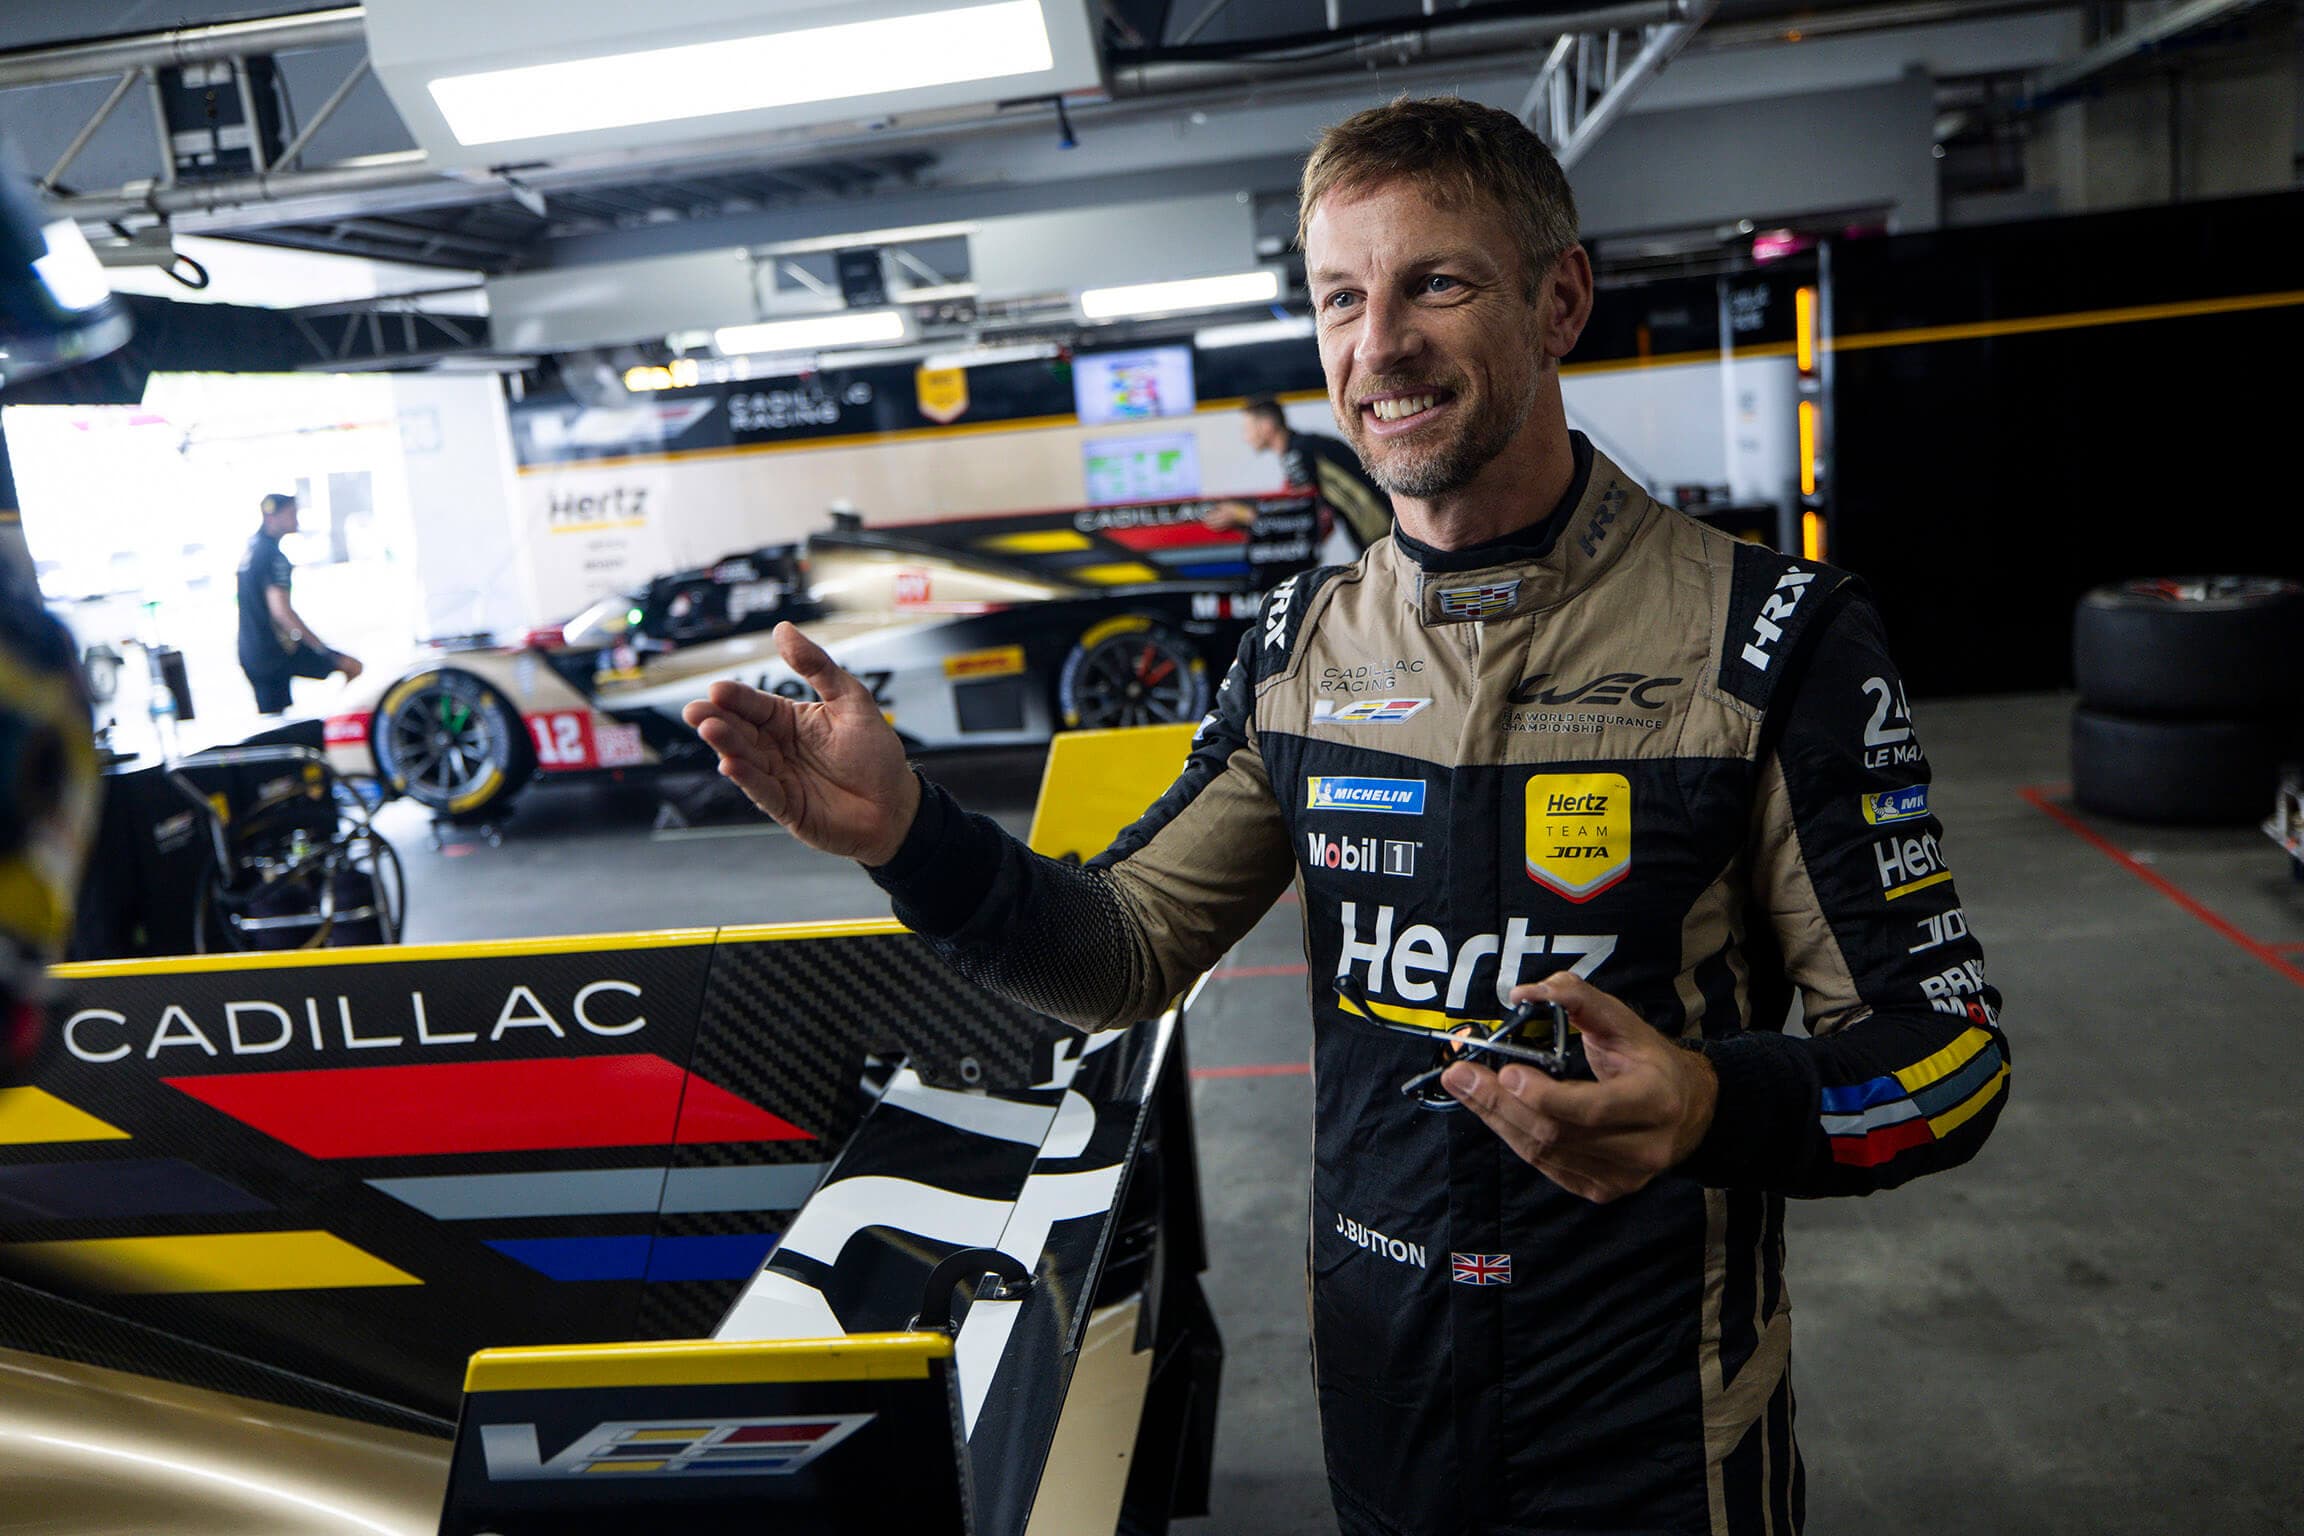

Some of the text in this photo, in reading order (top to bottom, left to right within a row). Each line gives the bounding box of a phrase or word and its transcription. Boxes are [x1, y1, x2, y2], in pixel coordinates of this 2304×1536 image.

[549, 487, 647, 521] Hertz
[1741, 566, 1816, 671] HRX
[1323, 660, 1425, 679] CADILLAC
[1320, 677, 1396, 692] RACING
[1506, 672, 1683, 710] WEC
[1502, 722, 1604, 734] CHAMPIONSHIP
[1526, 712, 1575, 723] WORLD
[1578, 713, 1663, 730] ENDURANCE
[534, 716, 585, 763] 12
[1864, 745, 1924, 769] LE MA
[1334, 788, 1413, 803] MICHELIN
[1547, 793, 1608, 812] Hertz
[1546, 825, 1608, 837] TEAM
[1307, 832, 1377, 873] Mobil
[1545, 846, 1609, 858] JOTA
[1337, 901, 1618, 1011] Hertz
[64, 980, 647, 1063] CADILLAC
[1336, 1213, 1426, 1269] J.BUTTON
